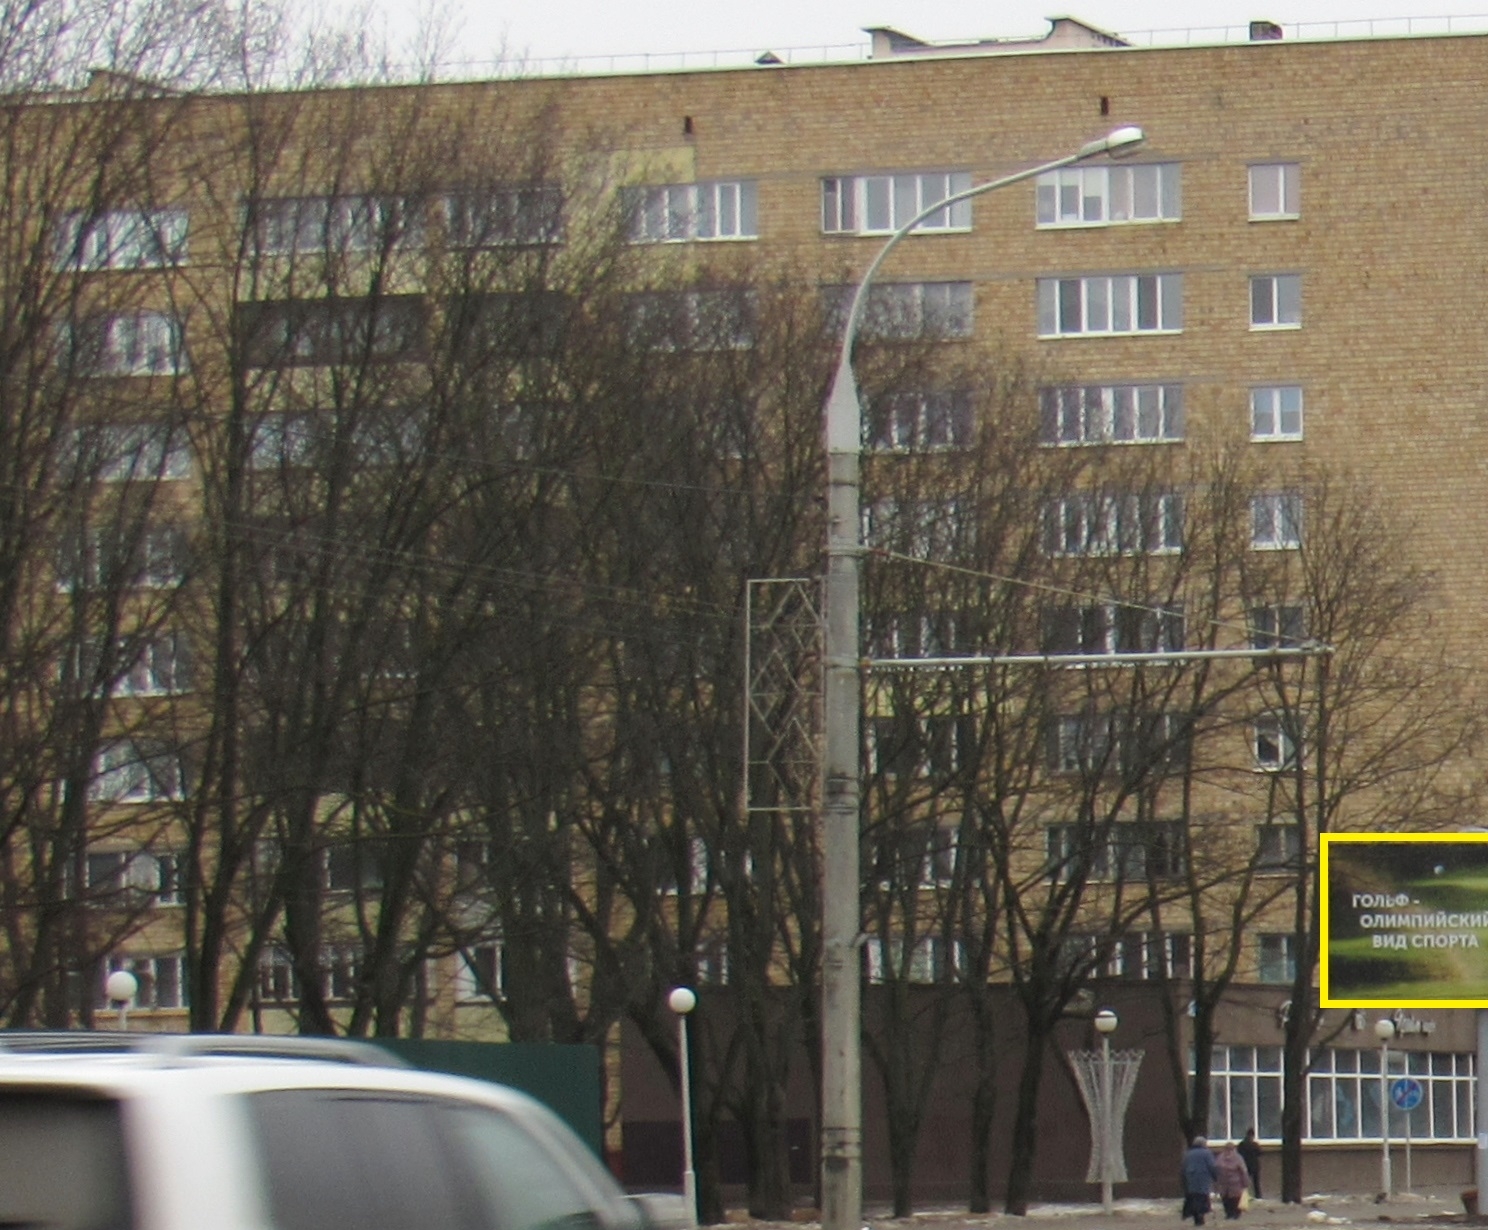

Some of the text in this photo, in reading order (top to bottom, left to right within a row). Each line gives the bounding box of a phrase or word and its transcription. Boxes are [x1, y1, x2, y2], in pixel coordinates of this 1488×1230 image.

[1352, 894, 1409, 908] ГОЛЬФ
[1372, 934, 1479, 950] ВИД СПОРТА
